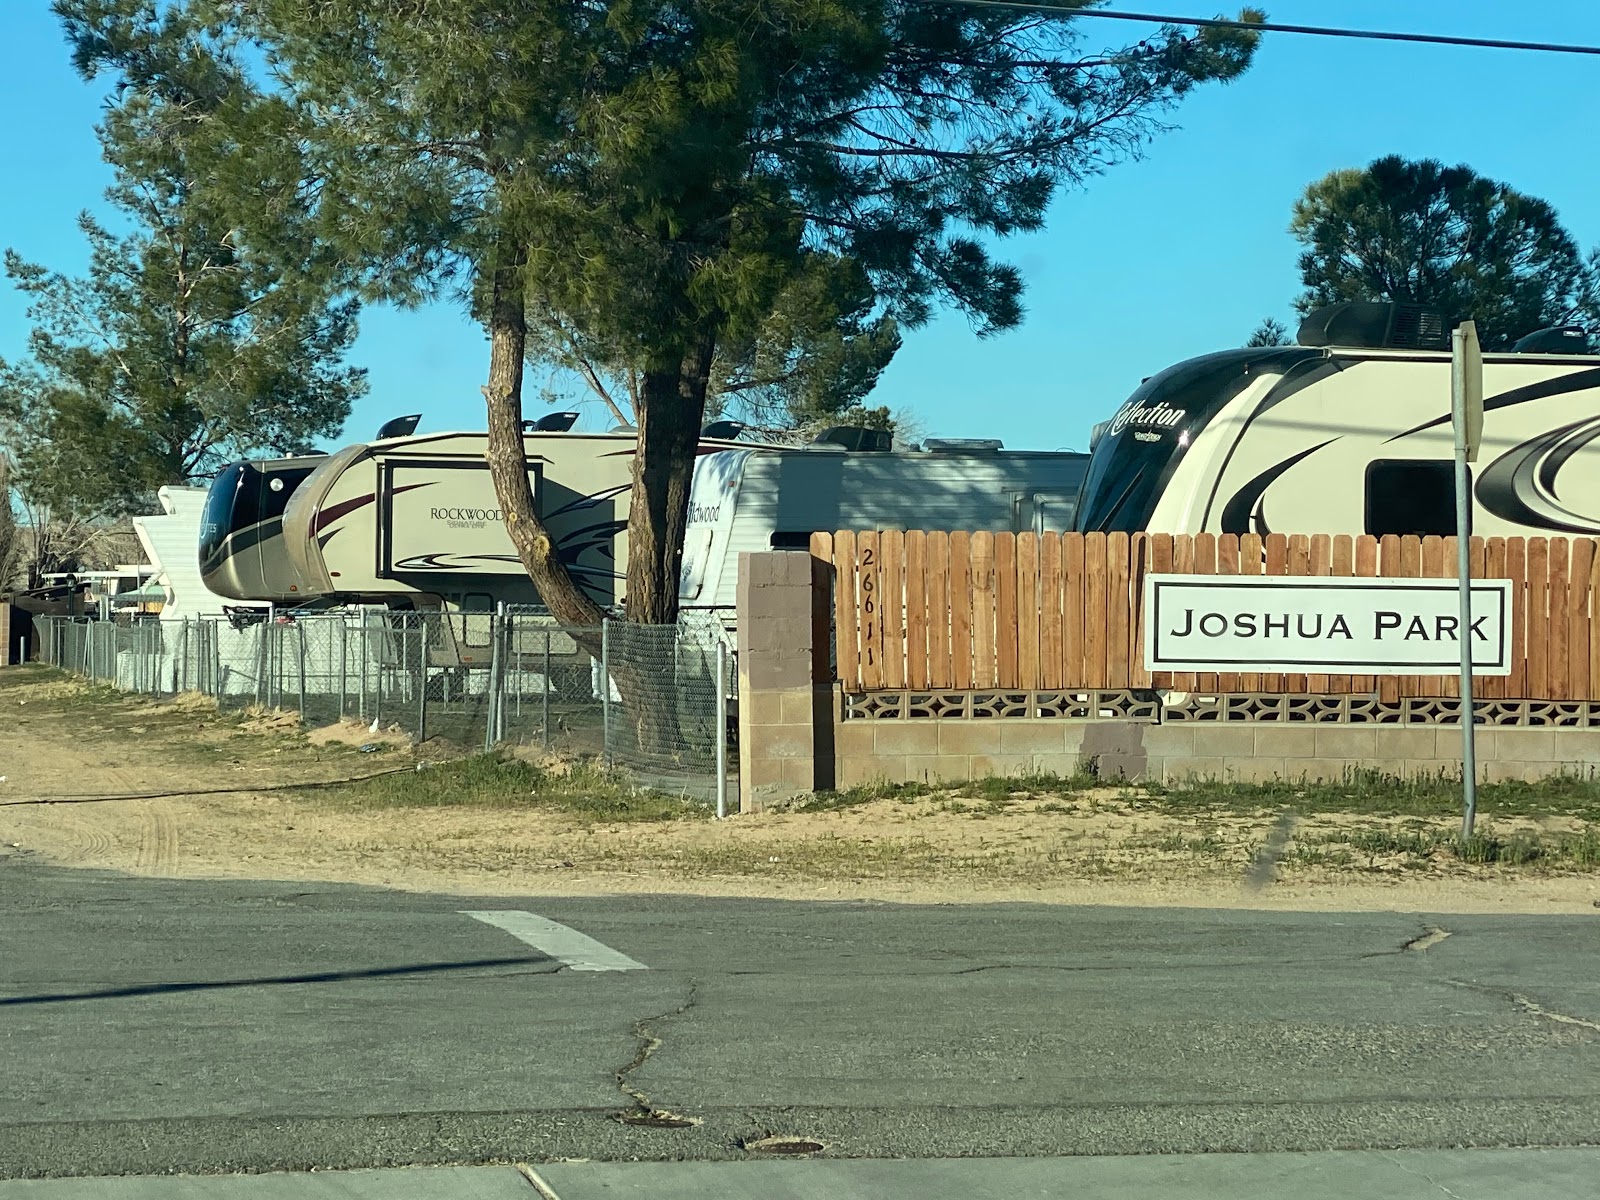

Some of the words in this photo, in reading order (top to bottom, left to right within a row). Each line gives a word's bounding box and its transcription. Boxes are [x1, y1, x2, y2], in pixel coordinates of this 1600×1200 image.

[1105, 400, 1186, 436] Reflection
[430, 507, 504, 521] ROCKWOOD
[687, 501, 721, 524] ildwood
[863, 549, 874, 666] 26611
[1170, 608, 1354, 640] JOSHUA
[1373, 611, 1489, 641] PARK
